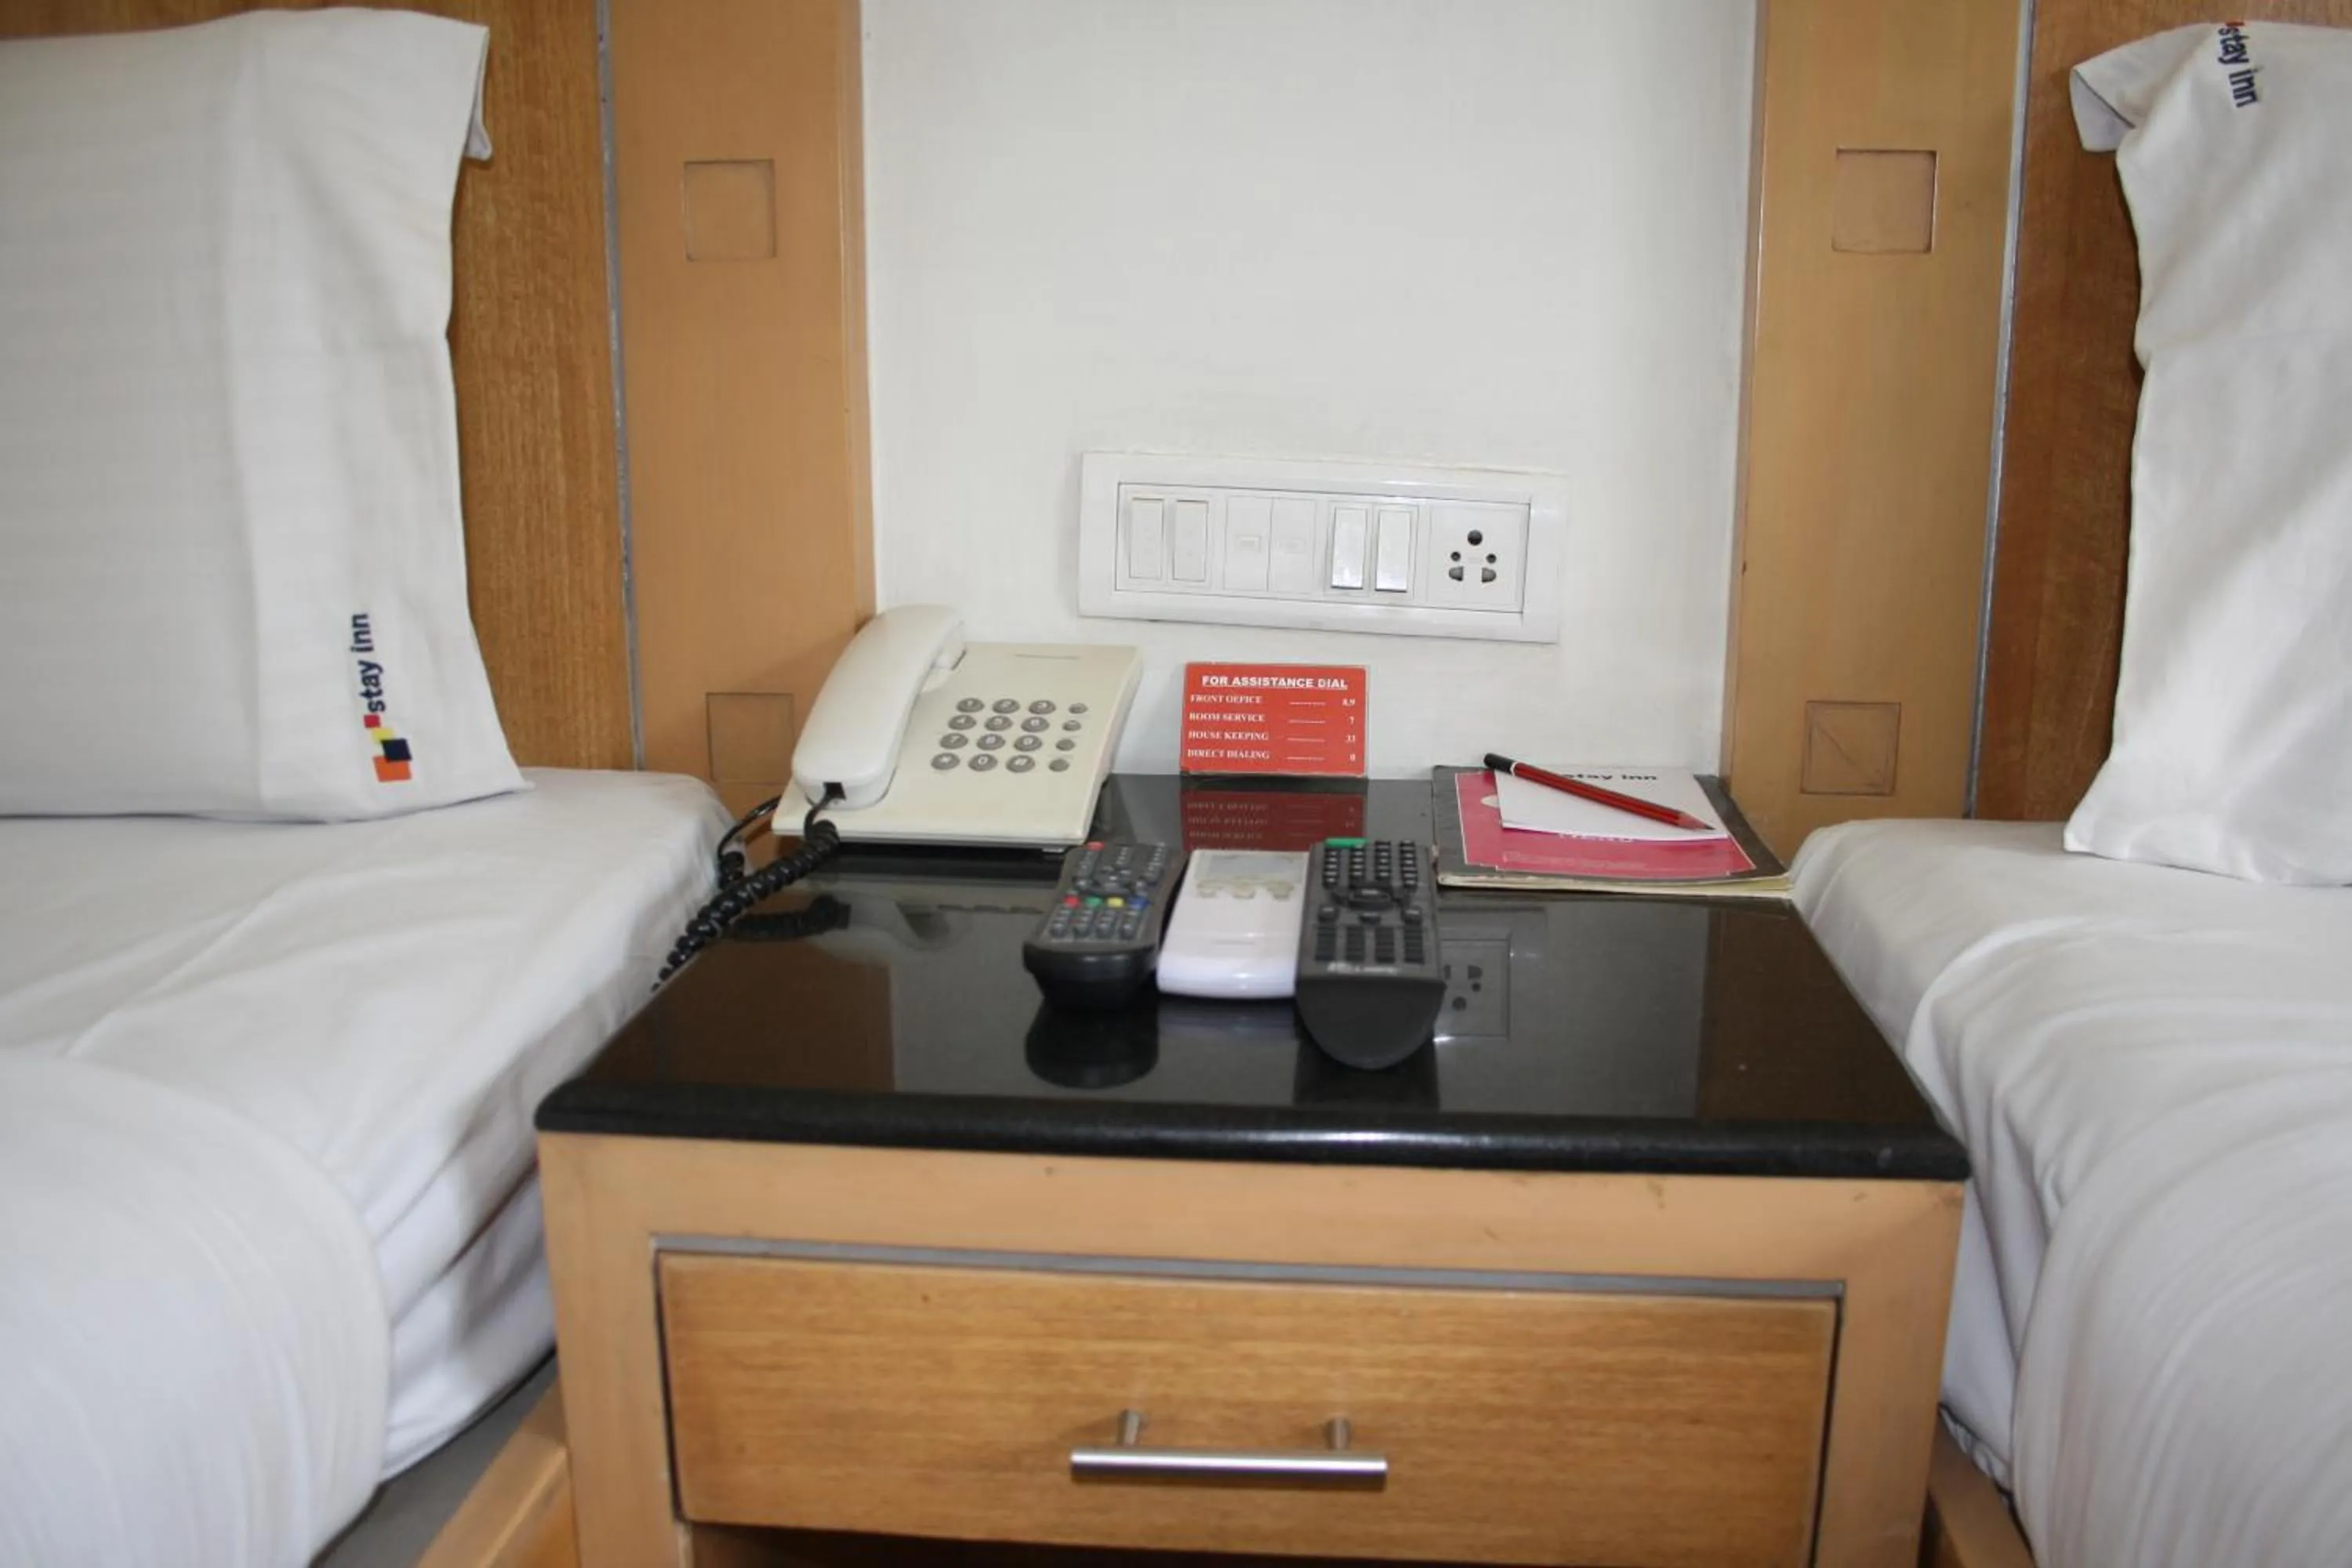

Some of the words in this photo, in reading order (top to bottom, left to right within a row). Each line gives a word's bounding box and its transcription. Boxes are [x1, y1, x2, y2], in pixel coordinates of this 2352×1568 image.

[2217, 27, 2250, 64] stay
[2228, 67, 2260, 108] inn
[350, 613, 375, 653] inn
[358, 659, 387, 713] stay
[1202, 675, 1229, 686] FOR
[1232, 677, 1315, 688] ASSISTANCE
[1317, 678, 1348, 688] DIAL
[1190, 694, 1224, 703] FRONT
[1225, 695, 1263, 704] OFFICE
[1189, 712, 1221, 721] ROOM
[1222, 713, 1265, 722] SERVICE
[1188, 730, 1222, 739] HOUSE
[1224, 731, 1269, 741] KEEPING
[1187, 749, 1225, 758] DIRECT
[1226, 750, 1270, 760] DIALING
